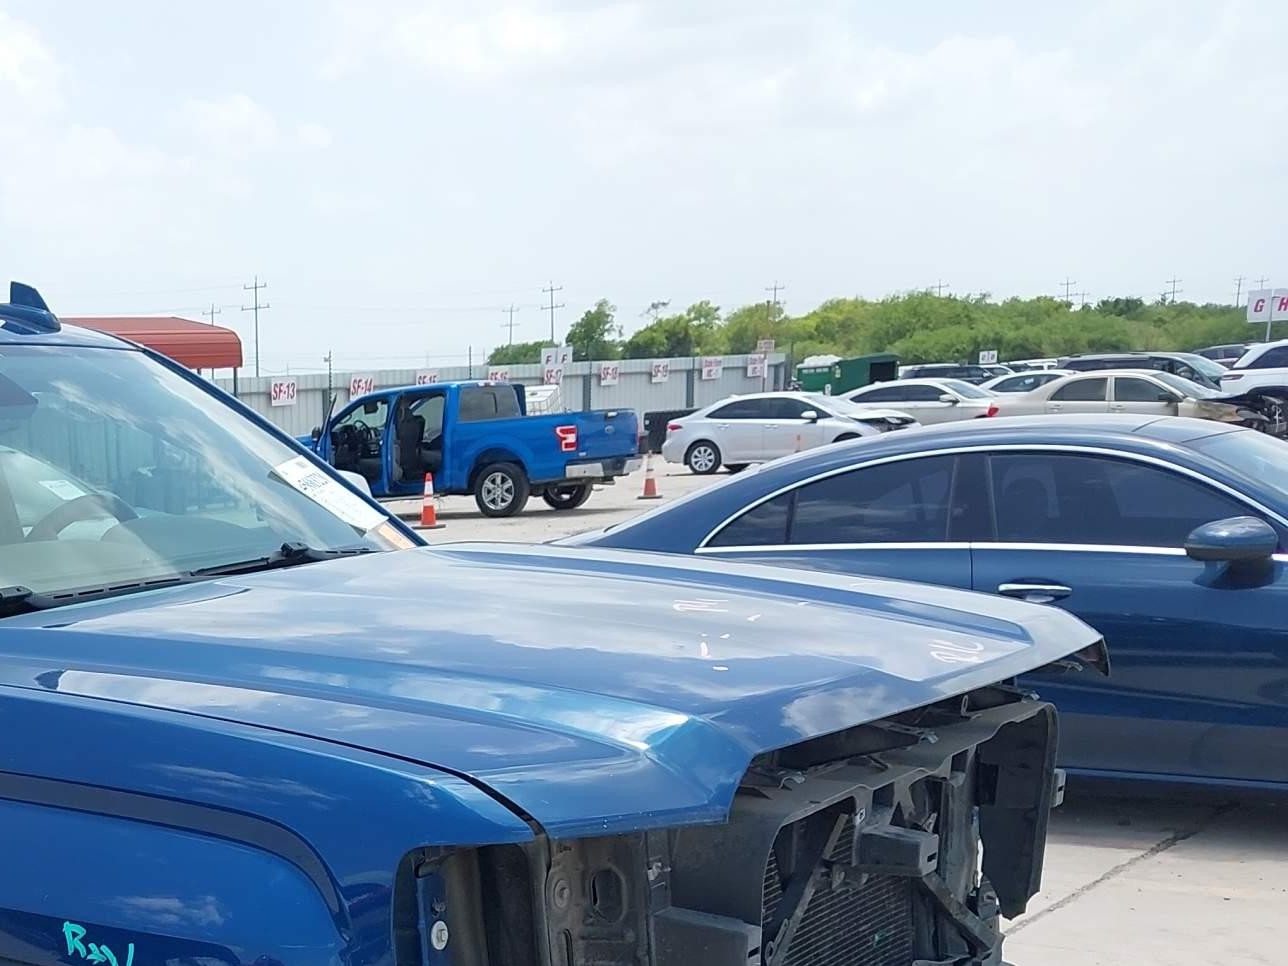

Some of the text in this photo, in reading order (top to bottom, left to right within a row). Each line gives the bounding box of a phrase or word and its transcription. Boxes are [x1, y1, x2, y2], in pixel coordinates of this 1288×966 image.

[1253, 298, 1265, 312] G
[272, 382, 296, 400] SF-13
[351, 378, 374, 396] SF-14
